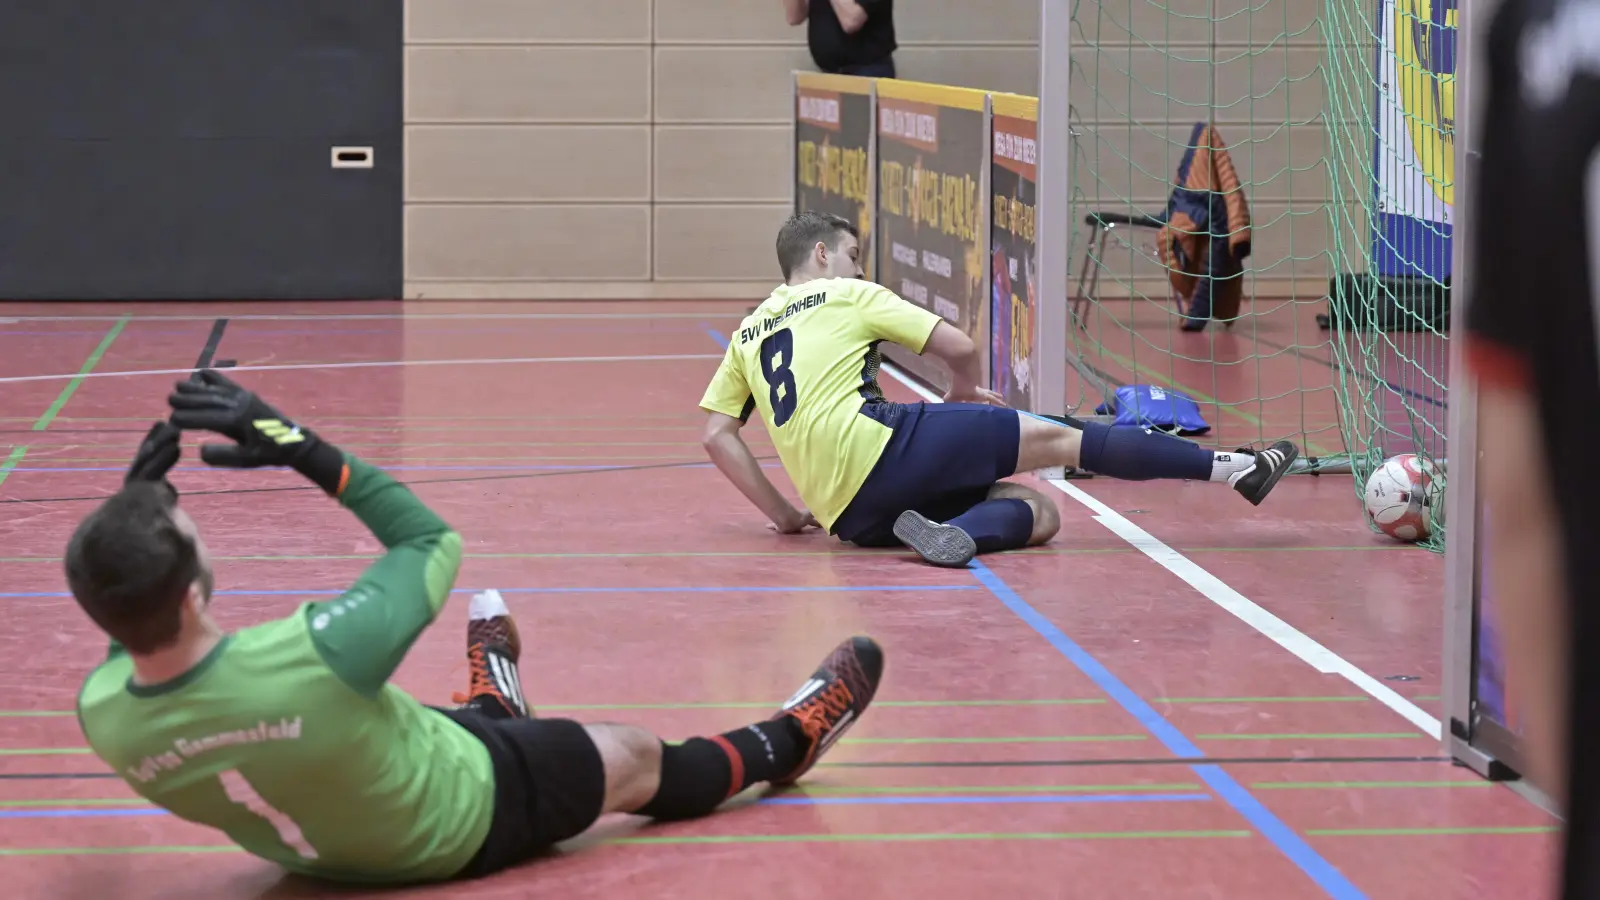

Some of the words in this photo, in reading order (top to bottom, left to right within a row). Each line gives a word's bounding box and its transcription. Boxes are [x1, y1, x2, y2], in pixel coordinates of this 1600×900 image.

[741, 322, 761, 345] SVV
[760, 327, 797, 427] 8
[218, 769, 319, 859] 1
